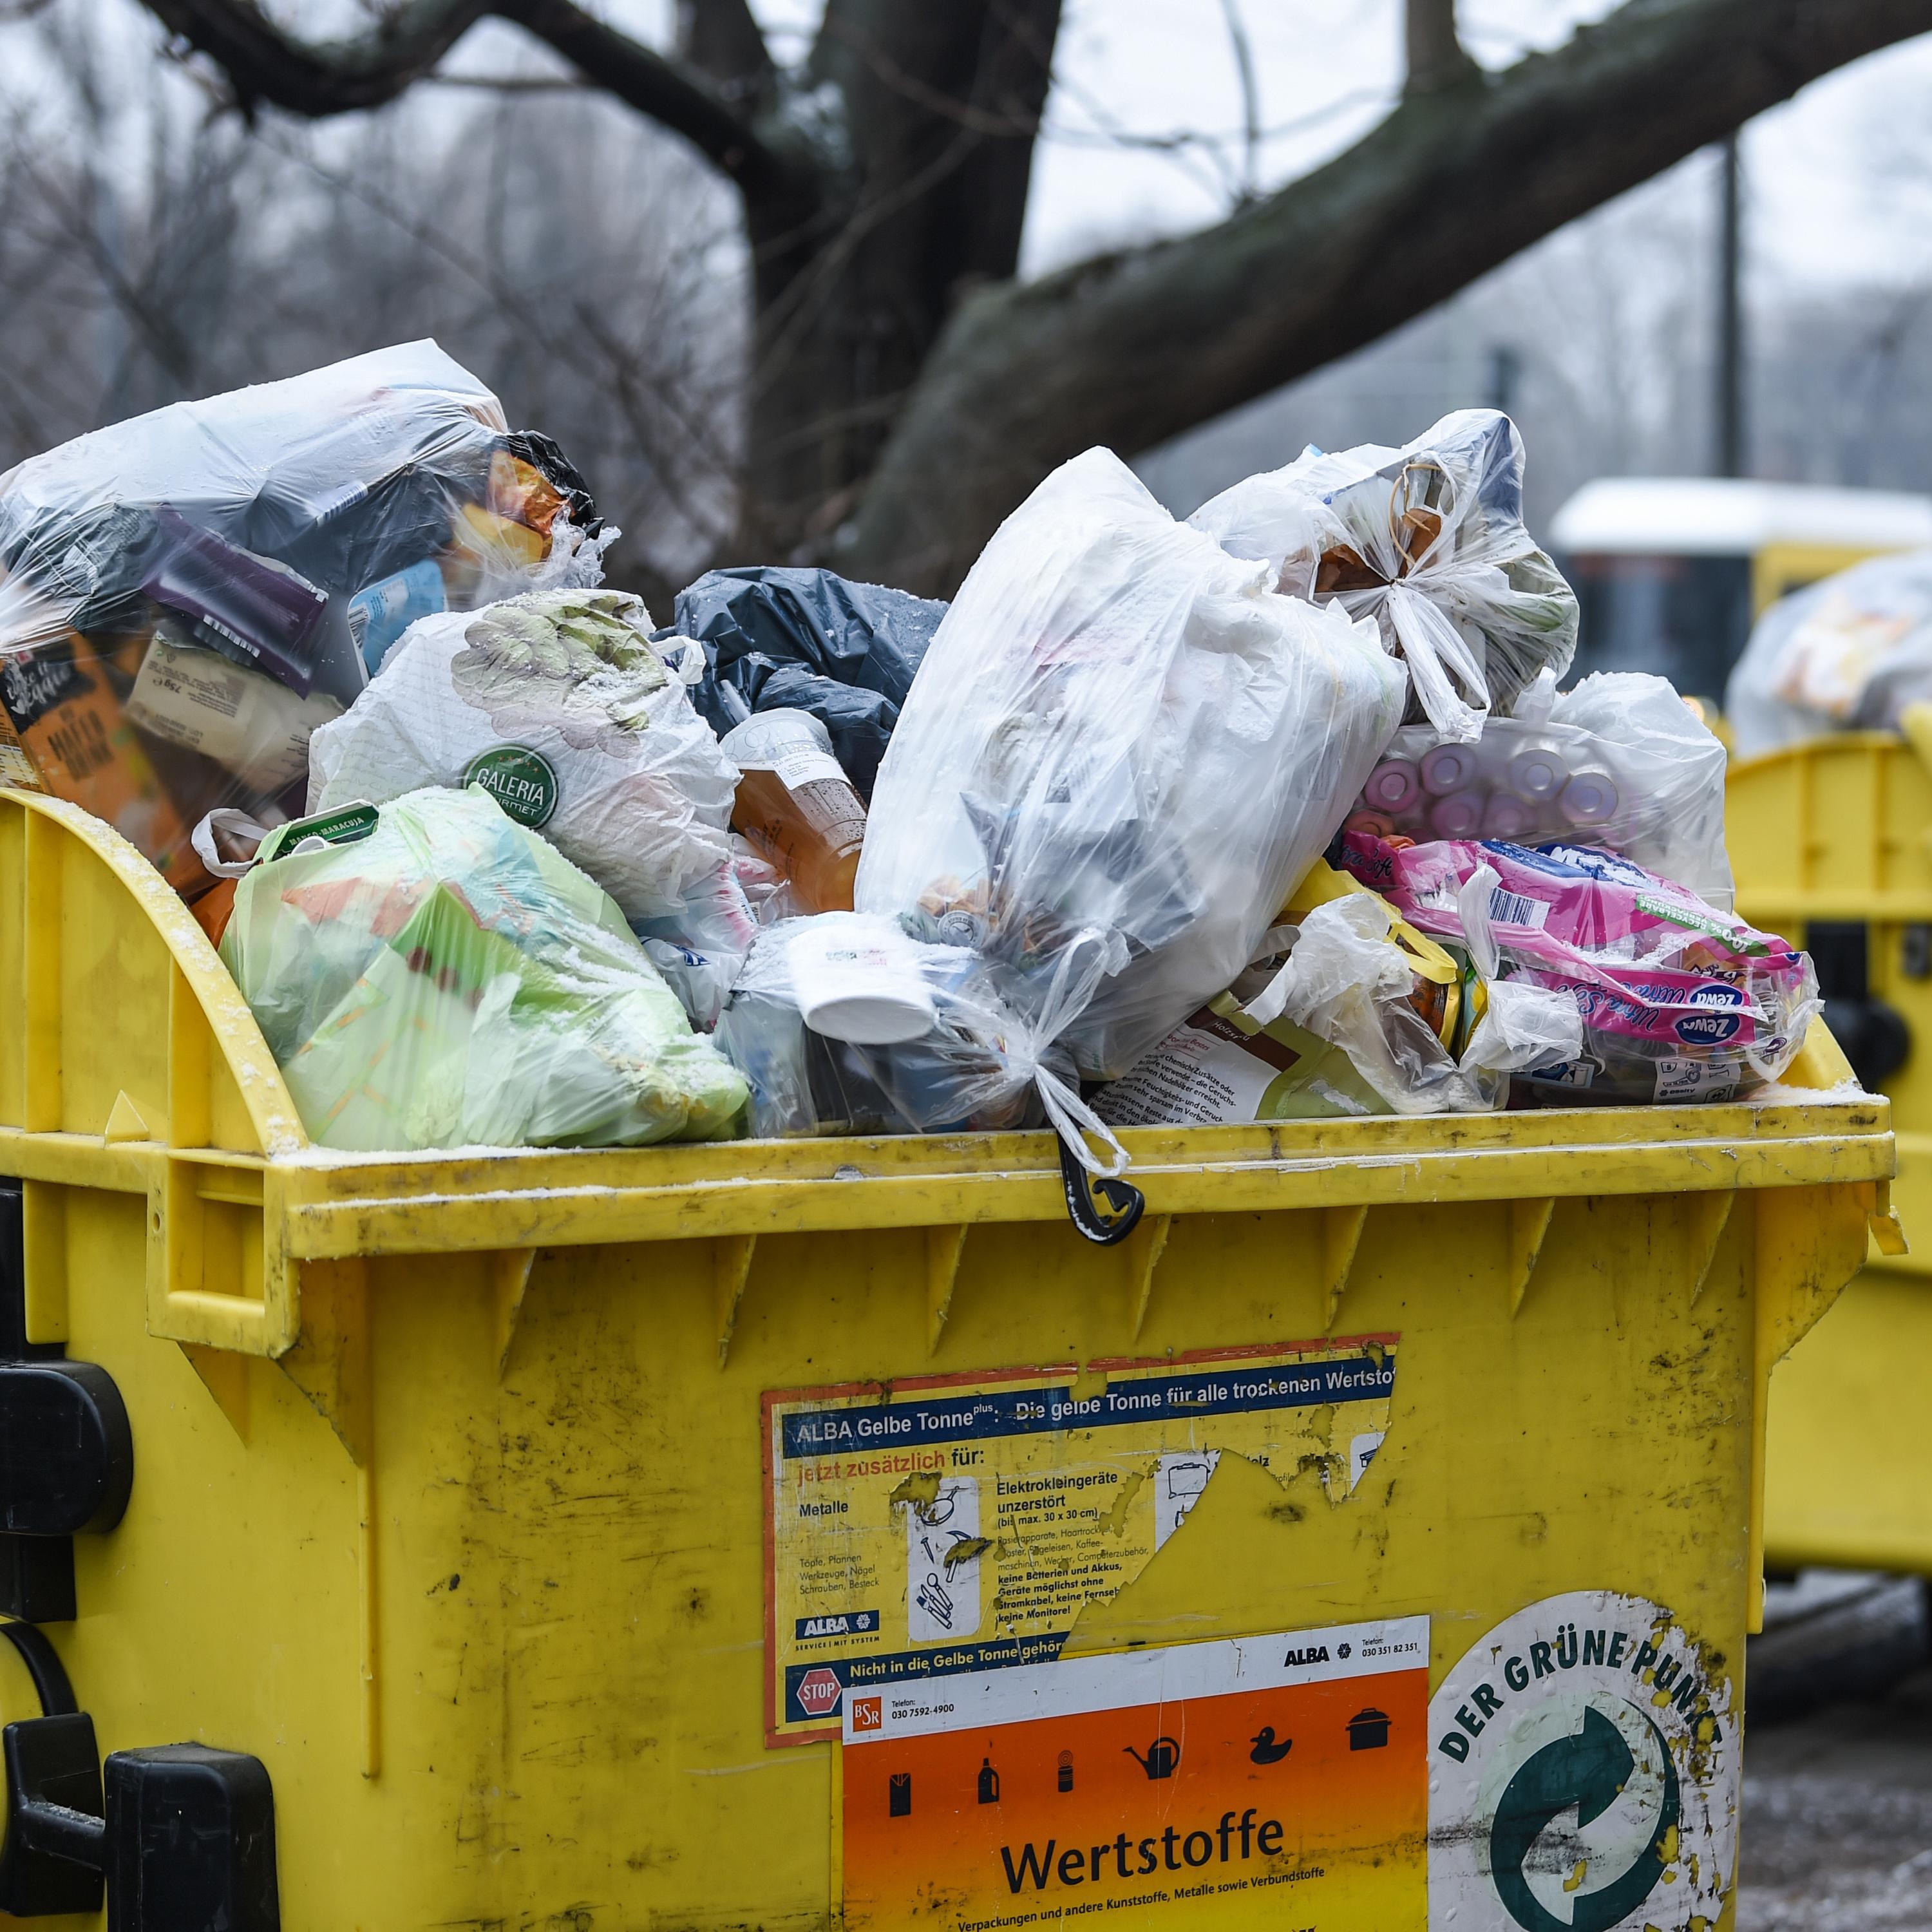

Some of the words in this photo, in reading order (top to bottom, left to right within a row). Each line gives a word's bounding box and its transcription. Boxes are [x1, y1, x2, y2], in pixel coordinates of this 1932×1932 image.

[477, 767, 545, 806] GALERIA
[1604, 995, 1660, 1032] Ultra
[1681, 1016, 1731, 1039] Zewa
[1193, 1066, 1220, 1087] Zusätze
[1220, 1083, 1235, 1097] oder
[1133, 1084, 1150, 1098] sehr
[1150, 1094, 1174, 1110] sparsam
[1174, 1104, 1184, 1113] im
[1194, 1088, 1221, 1109] erreicht.
[1196, 1079, 1208, 1090] die
[1208, 1085, 1237, 1107] Geruchs-
[1118, 1102, 1126, 1112] in
[1126, 1108, 1140, 1121] den
[1144, 1106, 1163, 1119] Reste
[1161, 1115, 1175, 1124] aus
[1185, 1099, 1200, 1110] und
[1115, 1112, 1128, 1124] die
[796, 1421, 853, 1443] ALBA
[857, 1416, 912, 1437] Gelbe
[1015, 1400, 1046, 1422] Die
[1106, 1392, 1162, 1413] Tonne
[1166, 1385, 1193, 1406] für
[1197, 1381, 1229, 1403] alle
[1233, 1372, 1321, 1400] trockenen
[796, 1461, 841, 1488] jetzt
[846, 1450, 945, 1477] zusätzlich
[951, 1448, 985, 1467] für:
[799, 1500, 849, 1517] Metalle
[996, 1471, 1119, 1496] Elektrokleingeräte
[998, 1494, 1066, 1514] unzerstört
[1018, 1515, 1041, 1526] max.
[1043, 1511, 1056, 1522] 30
[1066, 1509, 1078, 1520] 30
[1079, 1506, 1099, 1519] cm)
[1075, 1539, 1104, 1549] Kaffee-
[799, 1557, 826, 1569] Töpfe,
[828, 1554, 862, 1565] Pfannen
[799, 1569, 849, 1582] Werkzeuge,
[849, 1564, 876, 1577] Nägel
[998, 1574, 1024, 1585] keine
[1026, 1568, 1069, 1581] Batterien
[1070, 1564, 1089, 1576] und
[1091, 1562, 1123, 1573] Akkus,
[799, 1582, 847, 1595] Schrauben,
[849, 1577, 880, 1589] Besteck
[998, 1584, 1031, 1597] Geräte
[1033, 1580, 1079, 1595] möglichst
[1081, 1577, 1104, 1587] ohne
[999, 1596, 1054, 1610] Stromkabel,
[1056, 1591, 1082, 1603] keine
[998, 1612, 1024, 1624] keine
[1026, 1605, 1071, 1620] Monitore!
[804, 1616, 850, 1637] ALBA
[795, 1642, 826, 1651] SERVICE
[851, 1636, 880, 1645] SYSTEM
[1361, 1647, 1376, 1657] 030
[1379, 1645, 1391, 1656] 351
[1393, 1644, 1403, 1654] 82
[1405, 1642, 1418, 1652] 351
[849, 1660, 887, 1678] Nicht
[890, 1660, 904, 1673] in
[907, 1656, 930, 1672] die
[933, 1651, 974, 1669] Gelbe
[978, 1644, 1018, 1662] Tonne
[1283, 1645, 1331, 1668] ALBA
[802, 1681, 836, 1702] STOP
[1437, 1681, 1505, 1765] DER
[1504, 1622, 1629, 1692] GRÜNE
[891, 1698, 916, 1709] Telefon:
[891, 1710, 908, 1720] 030
[909, 1703, 955, 1718] 7592-4900
[854, 1702, 880, 1727] BSR
[1000, 1808, 1285, 1895] Wertstoffe
[958, 1911, 1037, 1932] Verpackungen
[1040, 1906, 1062, 1920] und
[1065, 1901, 1103, 1917] andere
[1106, 1890, 1171, 1911] Kunststoffe,
[1174, 1883, 1215, 1900] Metalle
[1217, 1878, 1248, 1893] sowie
[1250, 1866, 1325, 1888] Verbundstoffe
